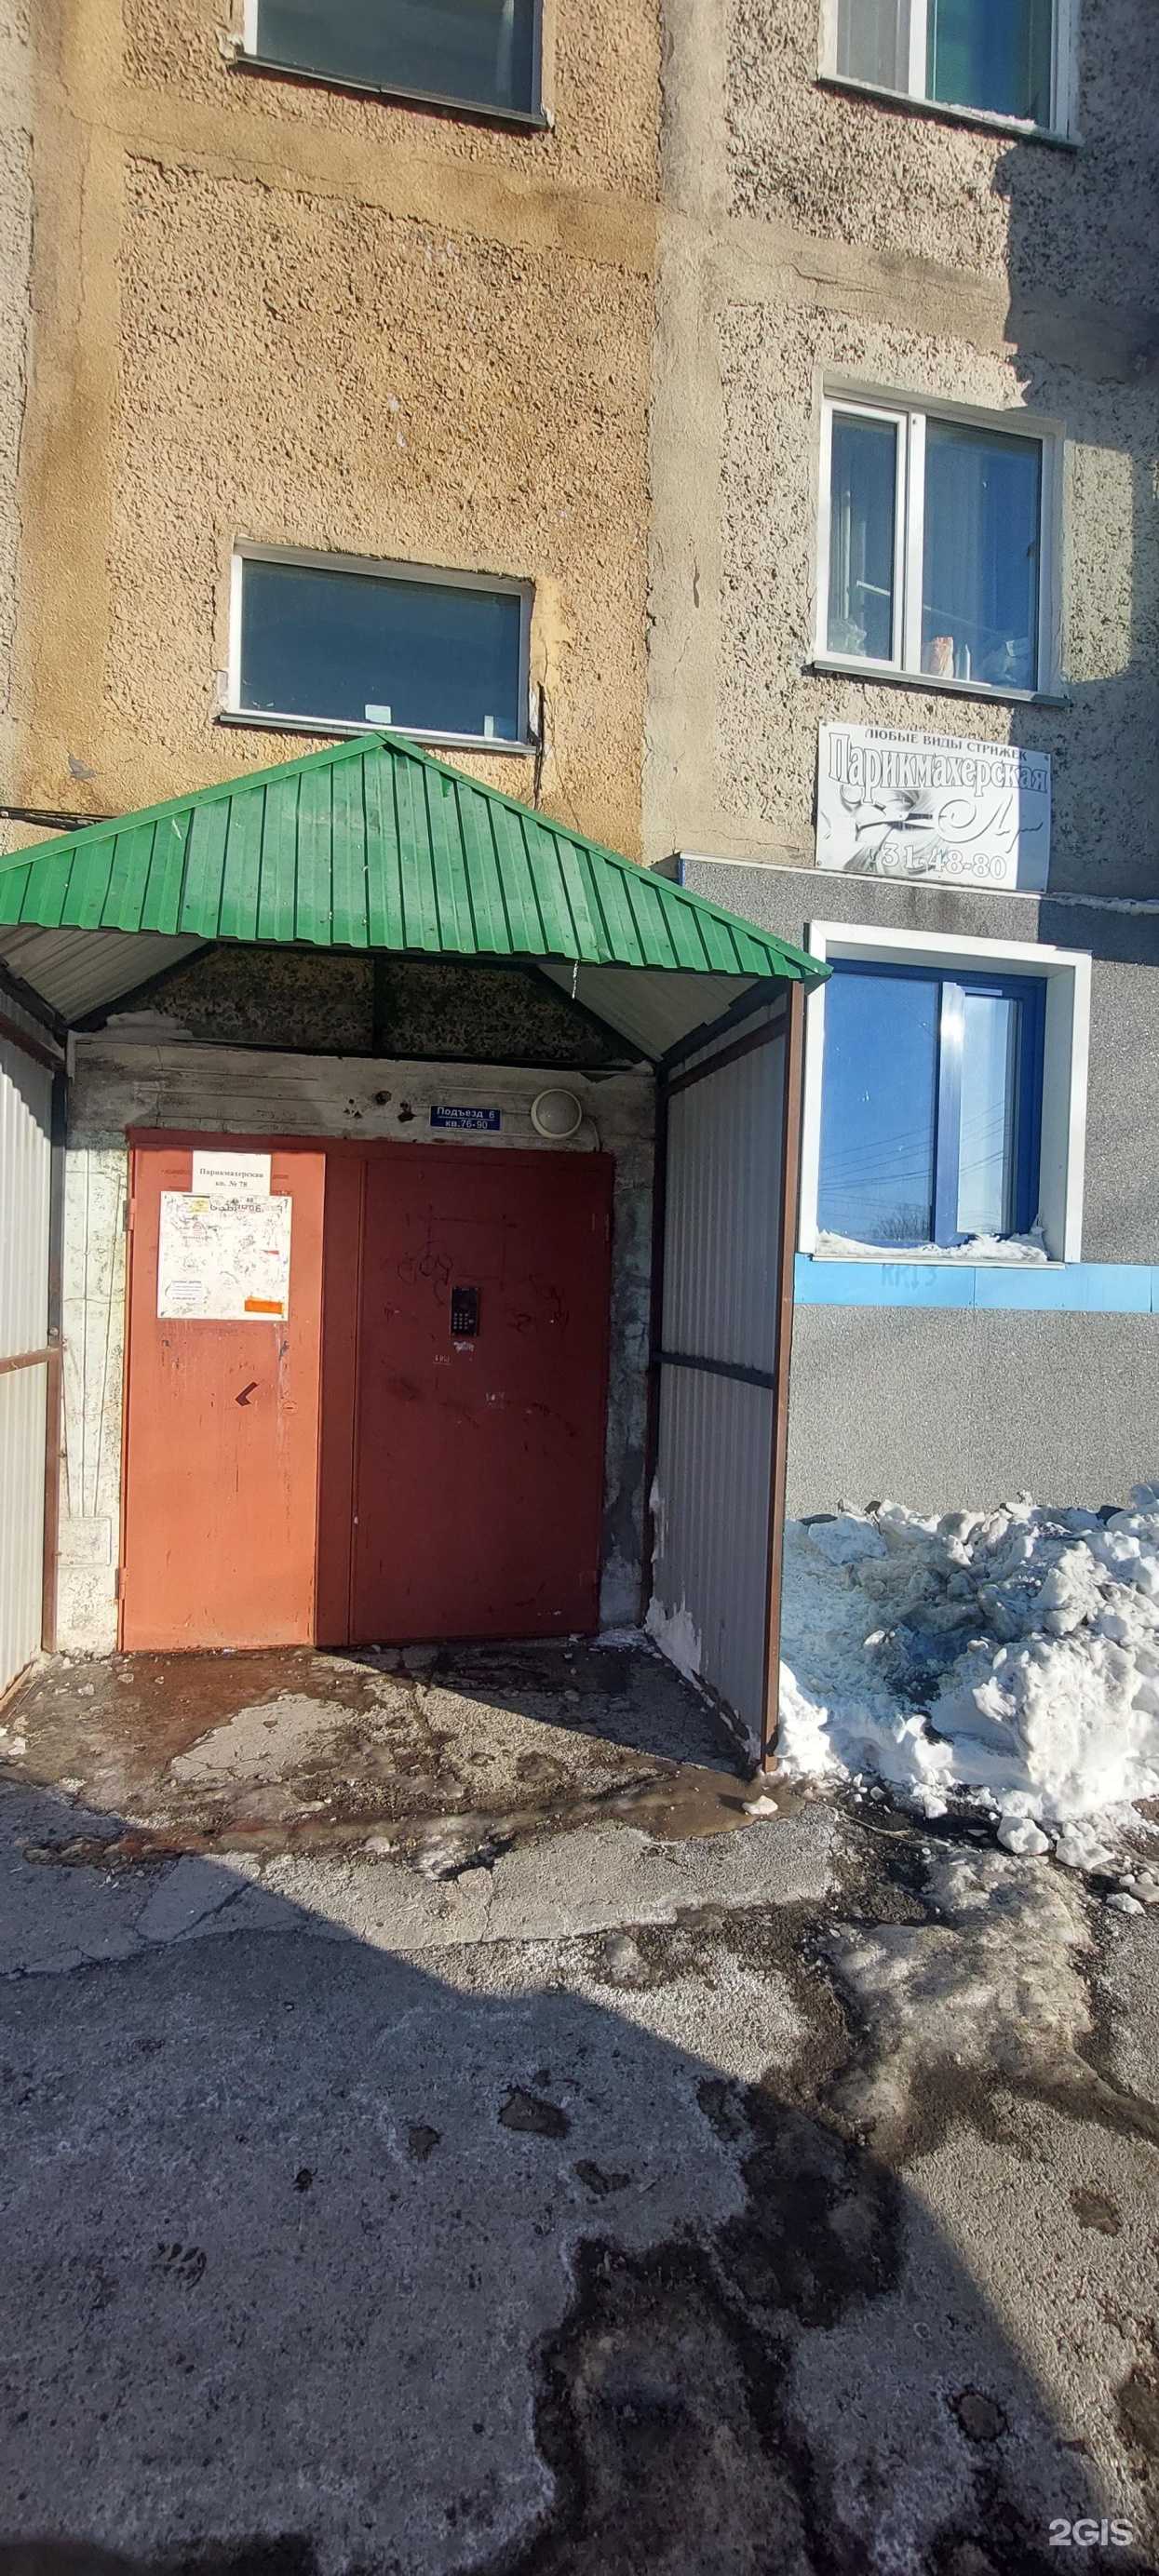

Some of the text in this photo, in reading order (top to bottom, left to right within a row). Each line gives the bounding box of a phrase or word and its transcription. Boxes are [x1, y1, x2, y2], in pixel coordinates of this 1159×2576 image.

[865, 728, 1028, 762] ЛЮБЫЕ ВИДЫ СТРИЖЕК
[829, 731, 1048, 805] Парикмахерская
[437, 1107, 495, 1119] Подъезд 6
[199, 1167, 264, 1178] Парикмахерская
